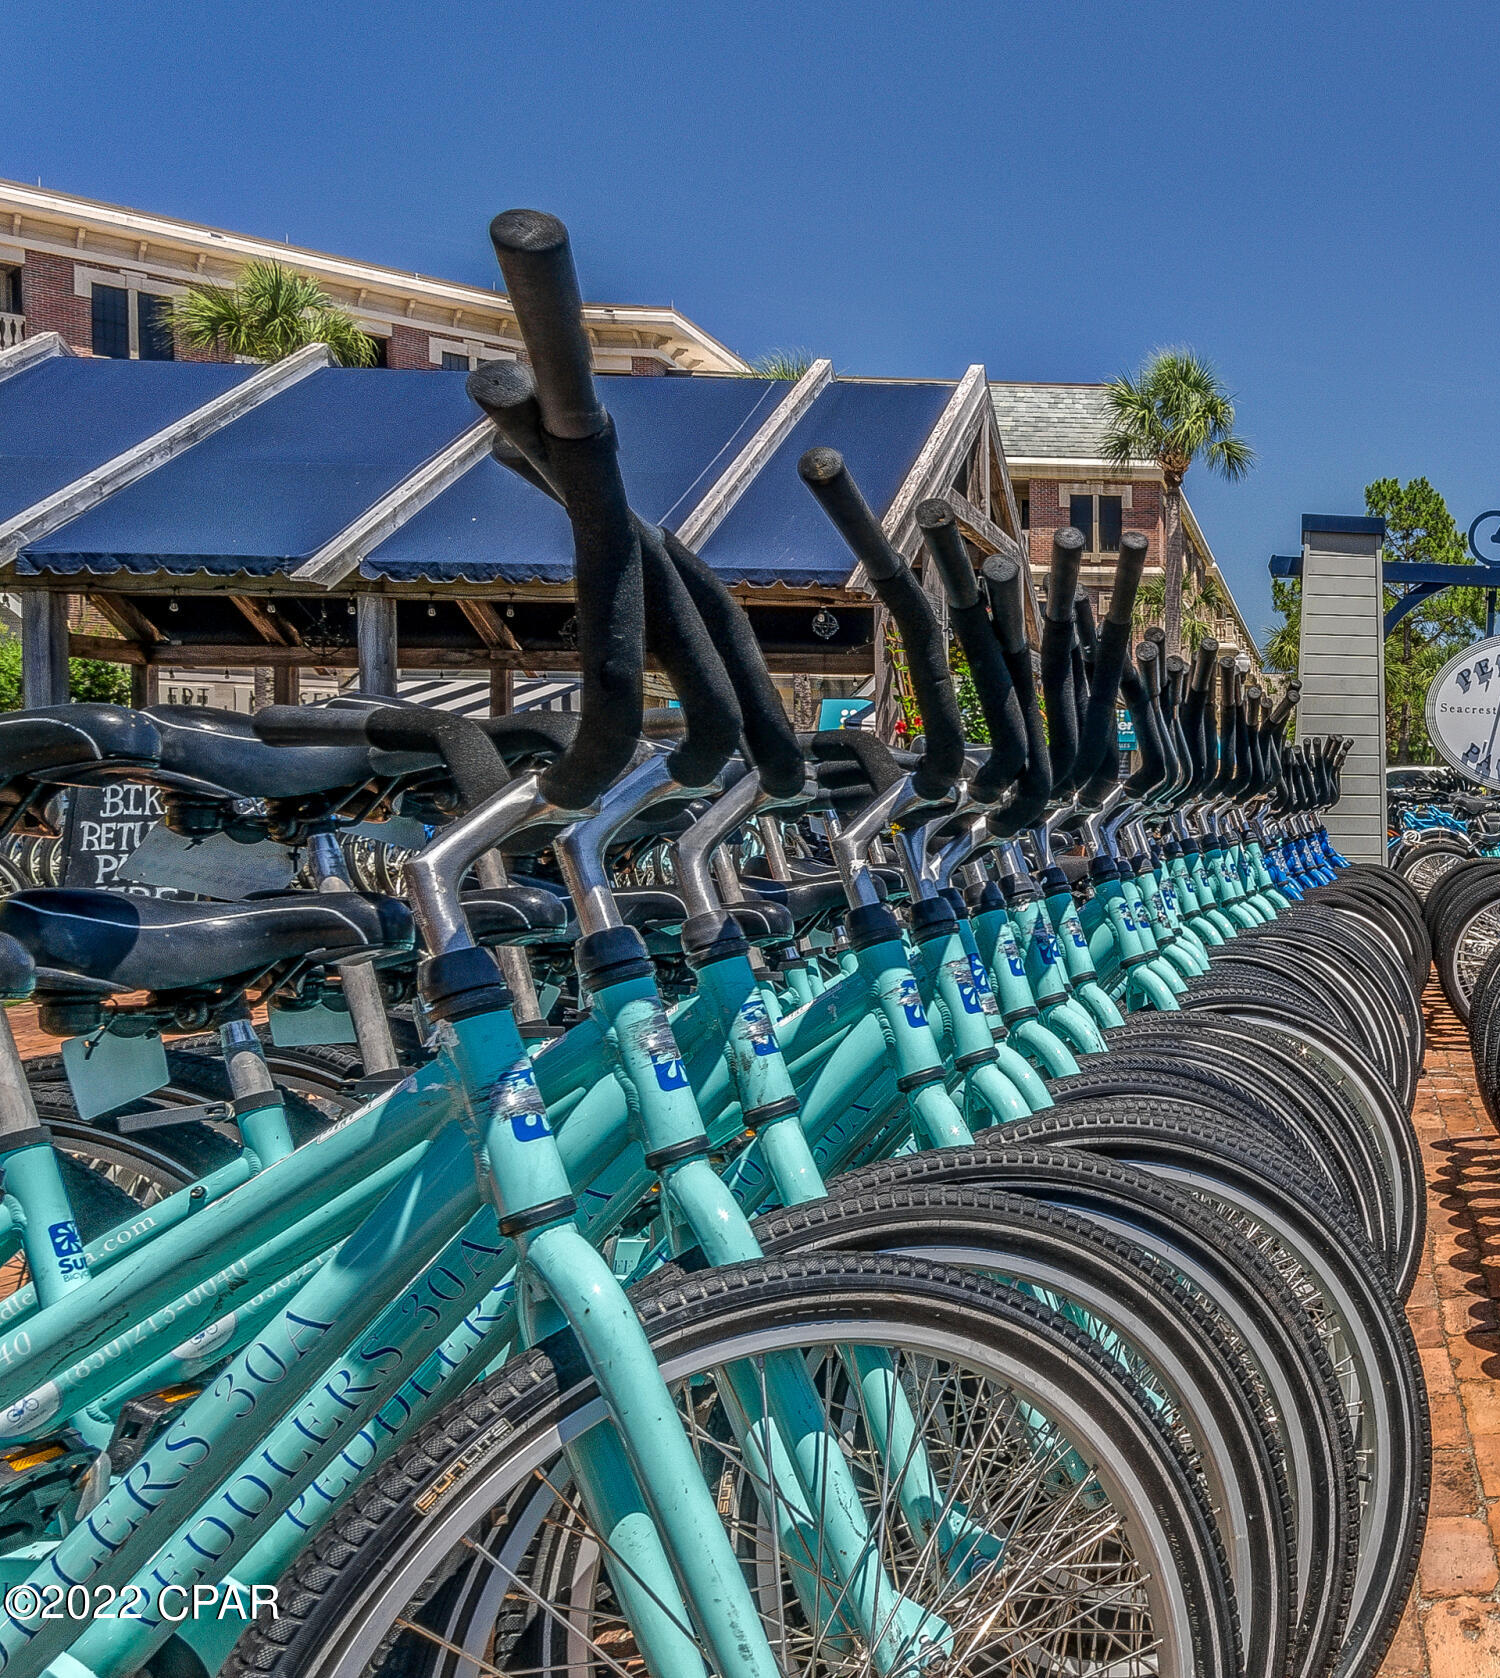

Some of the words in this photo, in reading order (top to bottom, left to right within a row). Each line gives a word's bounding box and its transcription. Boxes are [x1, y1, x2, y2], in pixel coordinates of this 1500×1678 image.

[1440, 703, 1497, 715] Seacrest
[100, 784, 169, 817] BIK
[401, 1238, 507, 1331] 30A
[214, 1310, 338, 1419] 30A
[417, 1421, 510, 1511] SUNLITE
